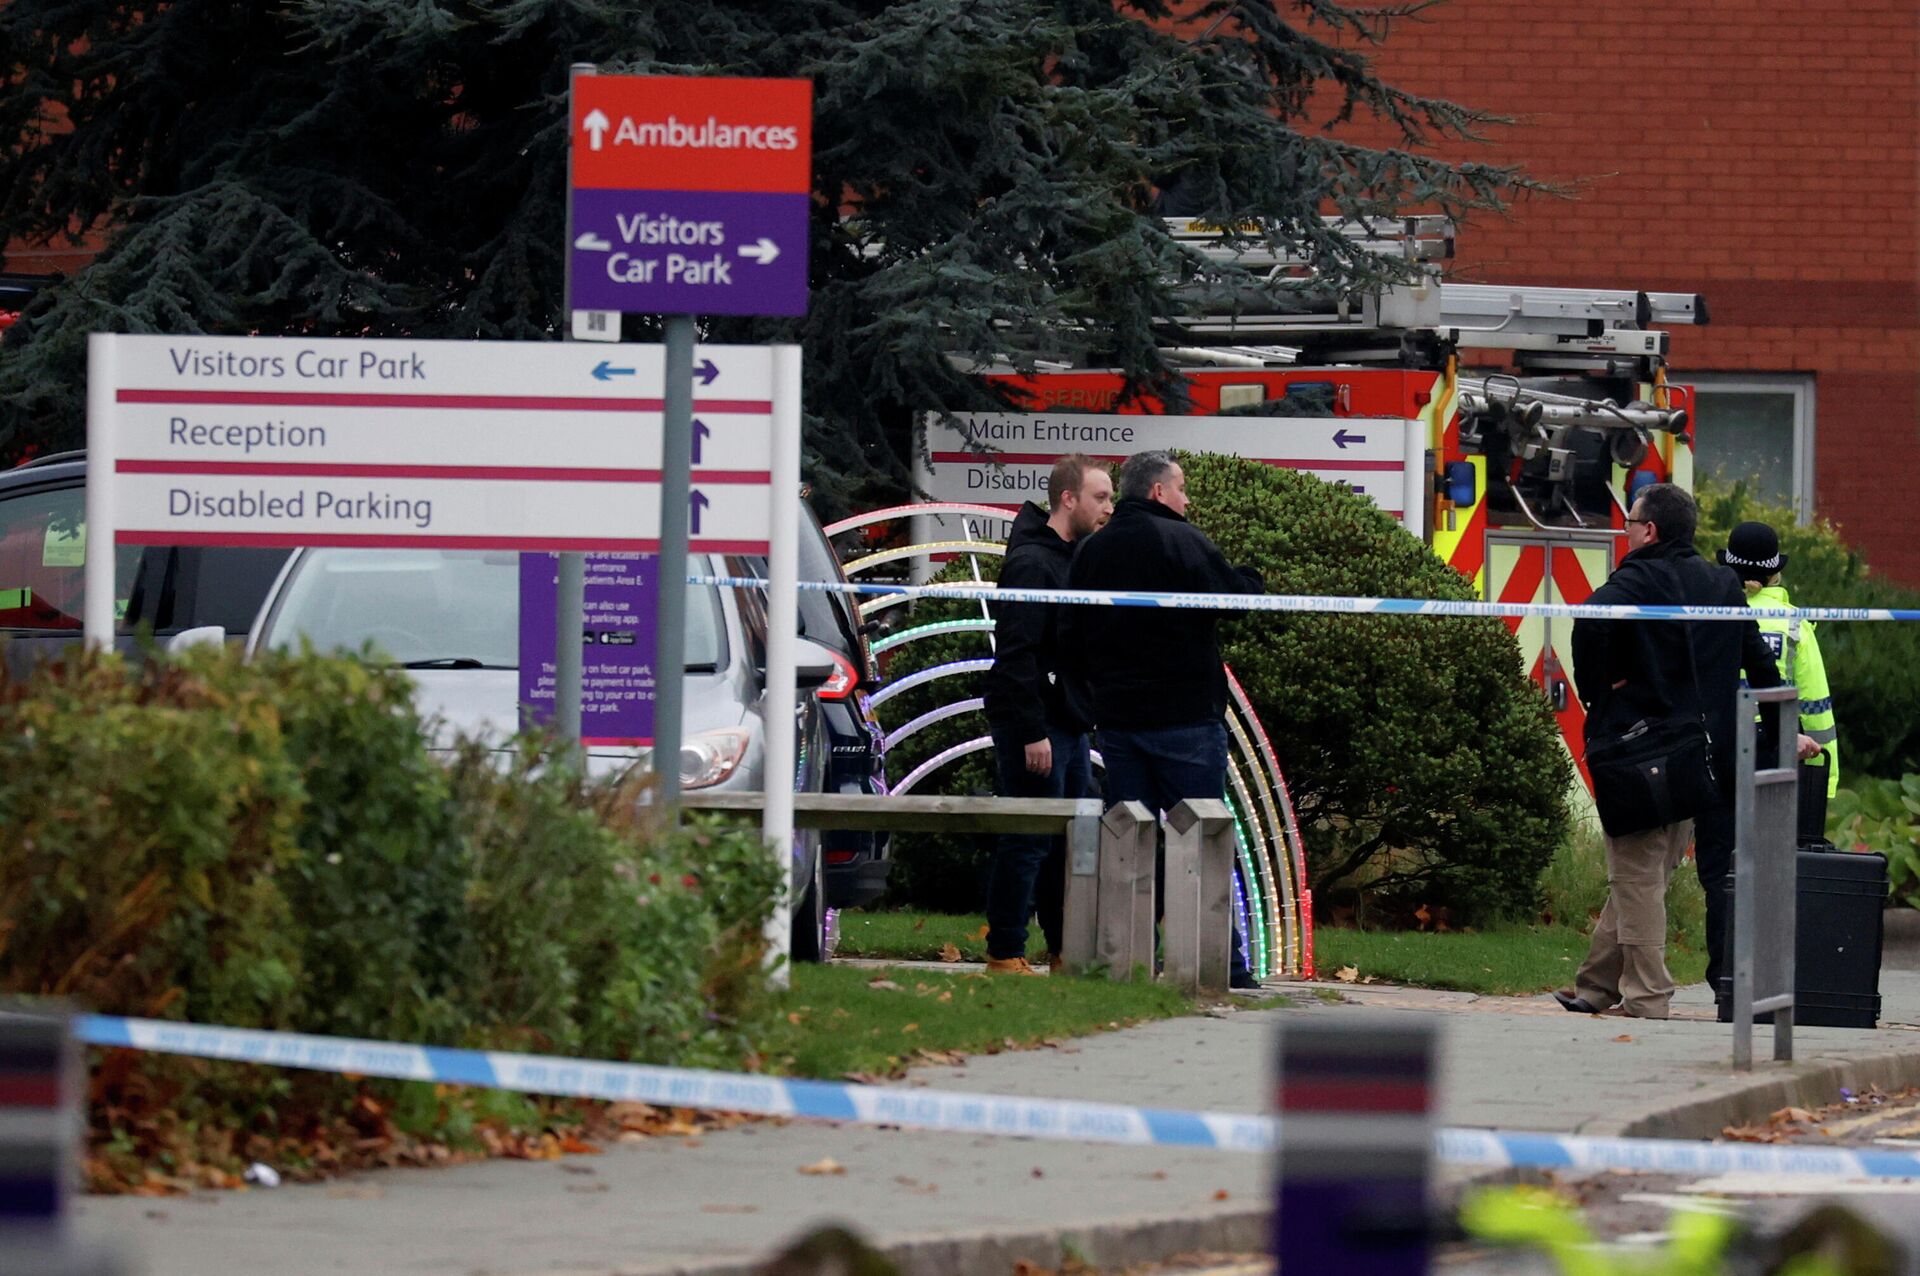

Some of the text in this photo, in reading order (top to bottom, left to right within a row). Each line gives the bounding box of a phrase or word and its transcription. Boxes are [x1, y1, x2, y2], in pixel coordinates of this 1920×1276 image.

[613, 115, 798, 150] Ambulances
[616, 213, 725, 246] Visitors
[606, 252, 732, 285] Car Park
[170, 348, 425, 380] Visitors Car Park
[1043, 389, 1120, 411] SERVIC
[169, 417, 326, 453] Reception
[969, 418, 1135, 442] Main Entrance
[968, 469, 1050, 491] Disable
[169, 488, 431, 528] Disabled Parking
[968, 519, 993, 540] All
